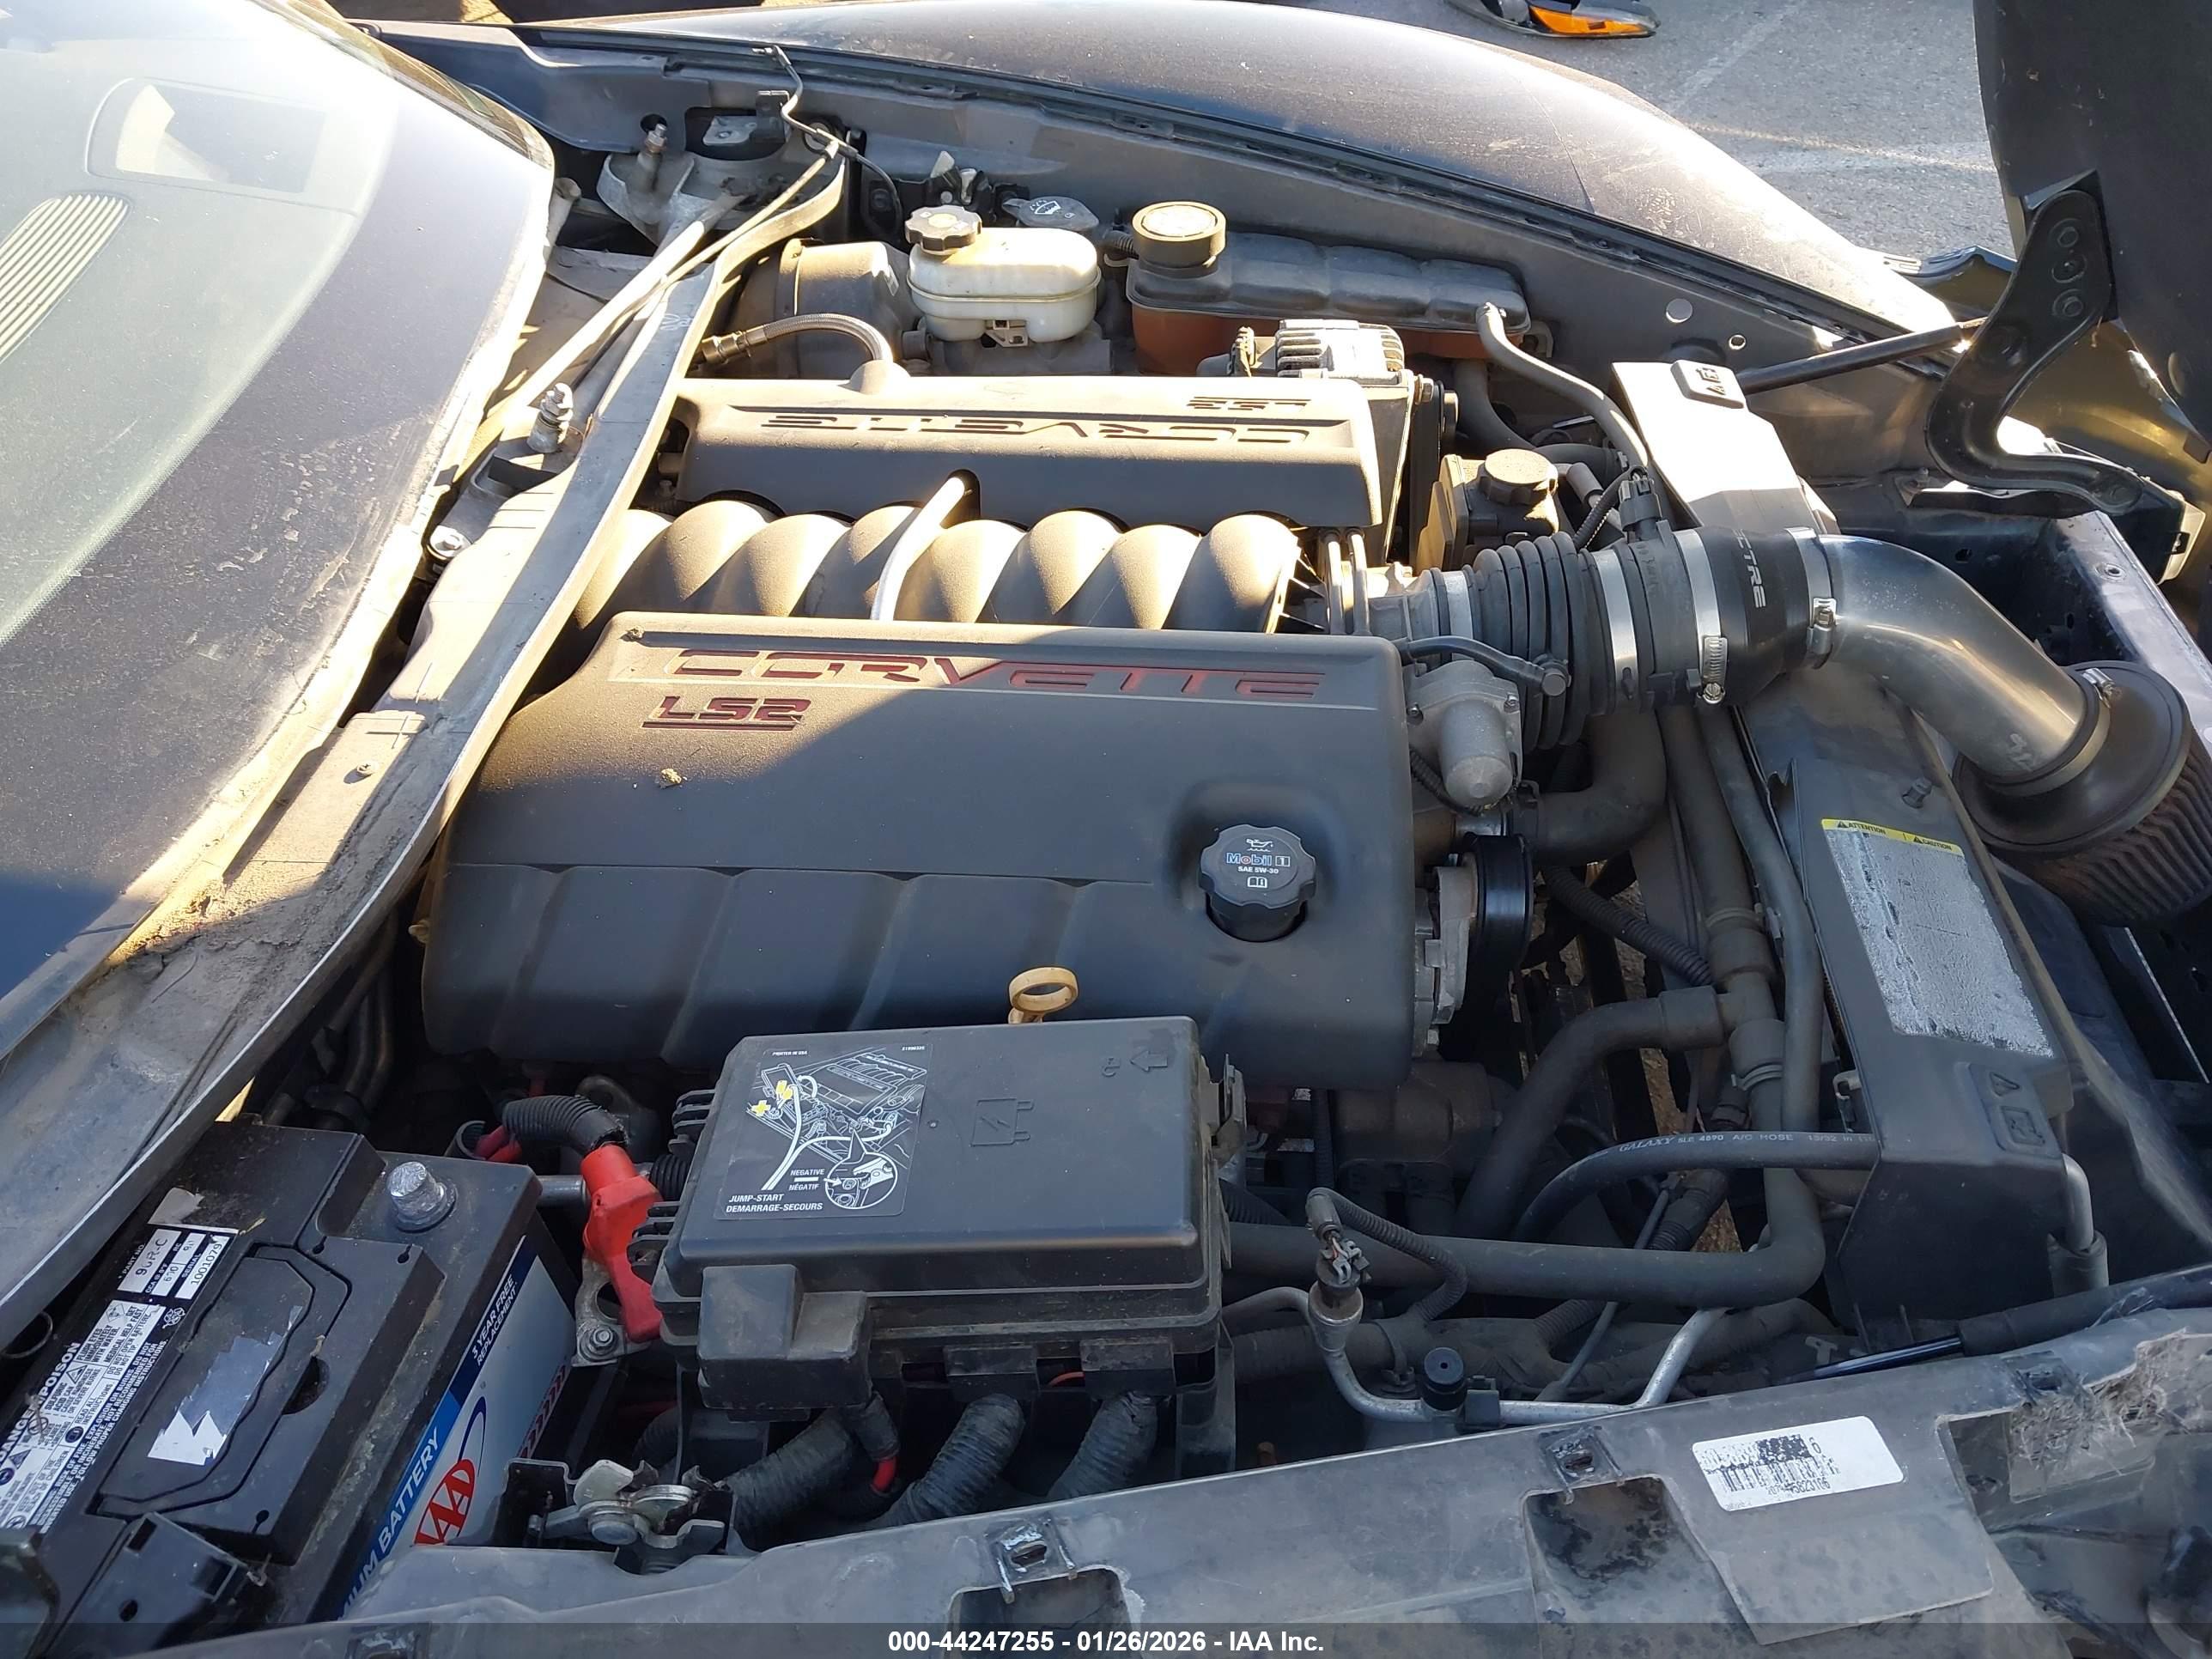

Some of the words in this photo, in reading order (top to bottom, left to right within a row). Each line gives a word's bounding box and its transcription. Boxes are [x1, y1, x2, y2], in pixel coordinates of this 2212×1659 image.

[667, 648, 1324, 698] CORVETTE
[655, 695, 811, 721] LS2
[1848, 822, 1886, 835] ATTENTION
[1922, 838, 1953, 850] CAUTION
[1226, 853, 1272, 866] Mobil
[1619, 1136, 1675, 1152] GALAXY
[1759, 1133, 1794, 1142] HOSE
[788, 1182, 820, 1191] NÉGATIF
[726, 1202, 823, 1212] DEMARRAGE-SECOURS
[728, 1194, 785, 1203] JUMP-START
[121, 1255, 137, 1273] PART
[180, 1252, 202, 1277] SERIAL
[189, 1243, 223, 1285] 1001079
[125, 1305, 138, 1316] GET
[475, 1308, 497, 1346] YEAR
[494, 1273, 515, 1313] FREE
[87, 1328, 103, 1342] EYES
[102, 1337, 125, 1363] MEDICAL
[118, 1323, 134, 1337] HELP
[90, 1347, 106, 1363] WITH
[112, 1353, 125, 1365] NOT
[119, 1337, 136, 1352] OPEN
[118, 1354, 131, 1366] NOT
[84, 1402, 113, 1438] EXPLOSION
[137, 1341, 152, 1355] NOT
[103, 1406, 118, 1420] NOT
[113, 1358, 149, 1405] RECOMMENDED
[144, 1343, 158, 1357] FOR
[44, 1382, 67, 1409] SULFURIC
[52, 1396, 67, 1410] ACID
[74, 1408, 89, 1424] READ
[85, 1396, 97, 1407] ALL
[74, 1449, 99, 1478] FOLLOW
[93, 1421, 116, 1449] PROPER
[110, 1388, 137, 1420] CHARGING
[378, 1426, 438, 1553] BATTERY
